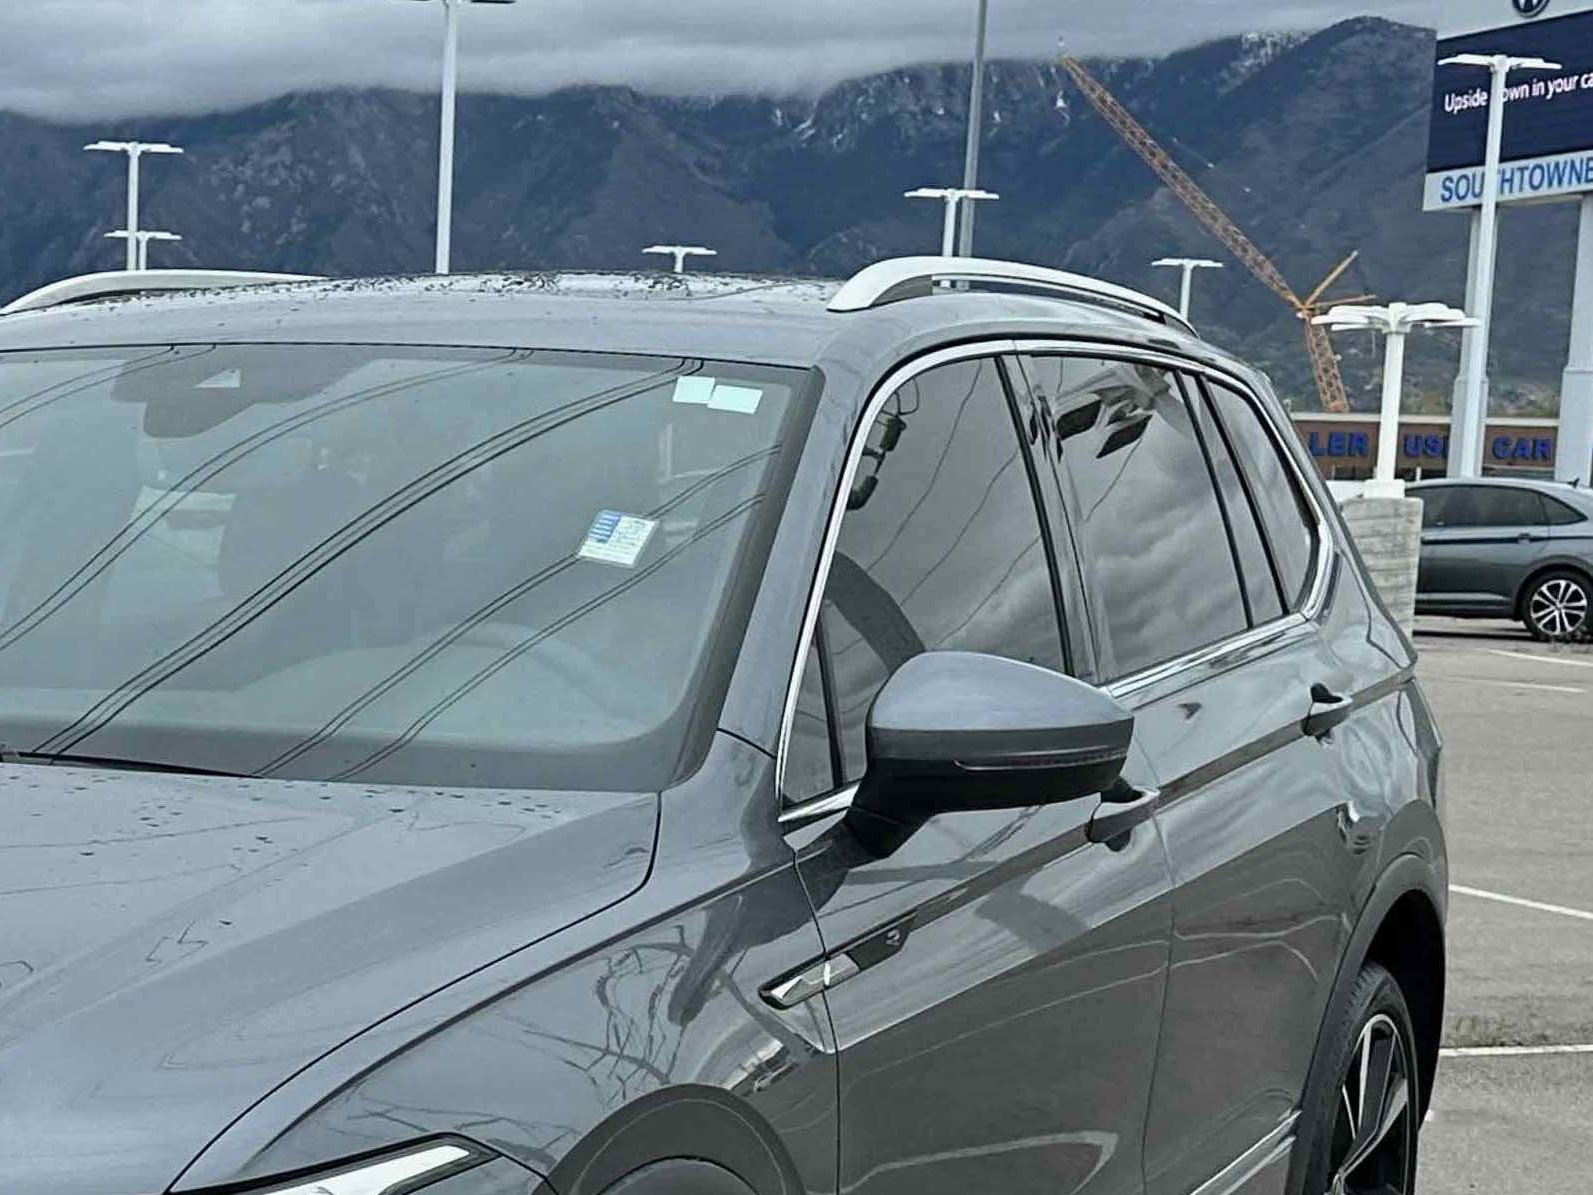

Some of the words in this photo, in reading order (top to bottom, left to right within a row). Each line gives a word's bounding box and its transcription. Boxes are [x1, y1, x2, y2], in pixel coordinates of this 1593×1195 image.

[1444, 87, 1488, 115] Upside
[1500, 84, 1529, 102] own
[1532, 78, 1545, 97] in
[1546, 75, 1579, 100] your
[1440, 156, 1593, 203] SOUHTOWNE
